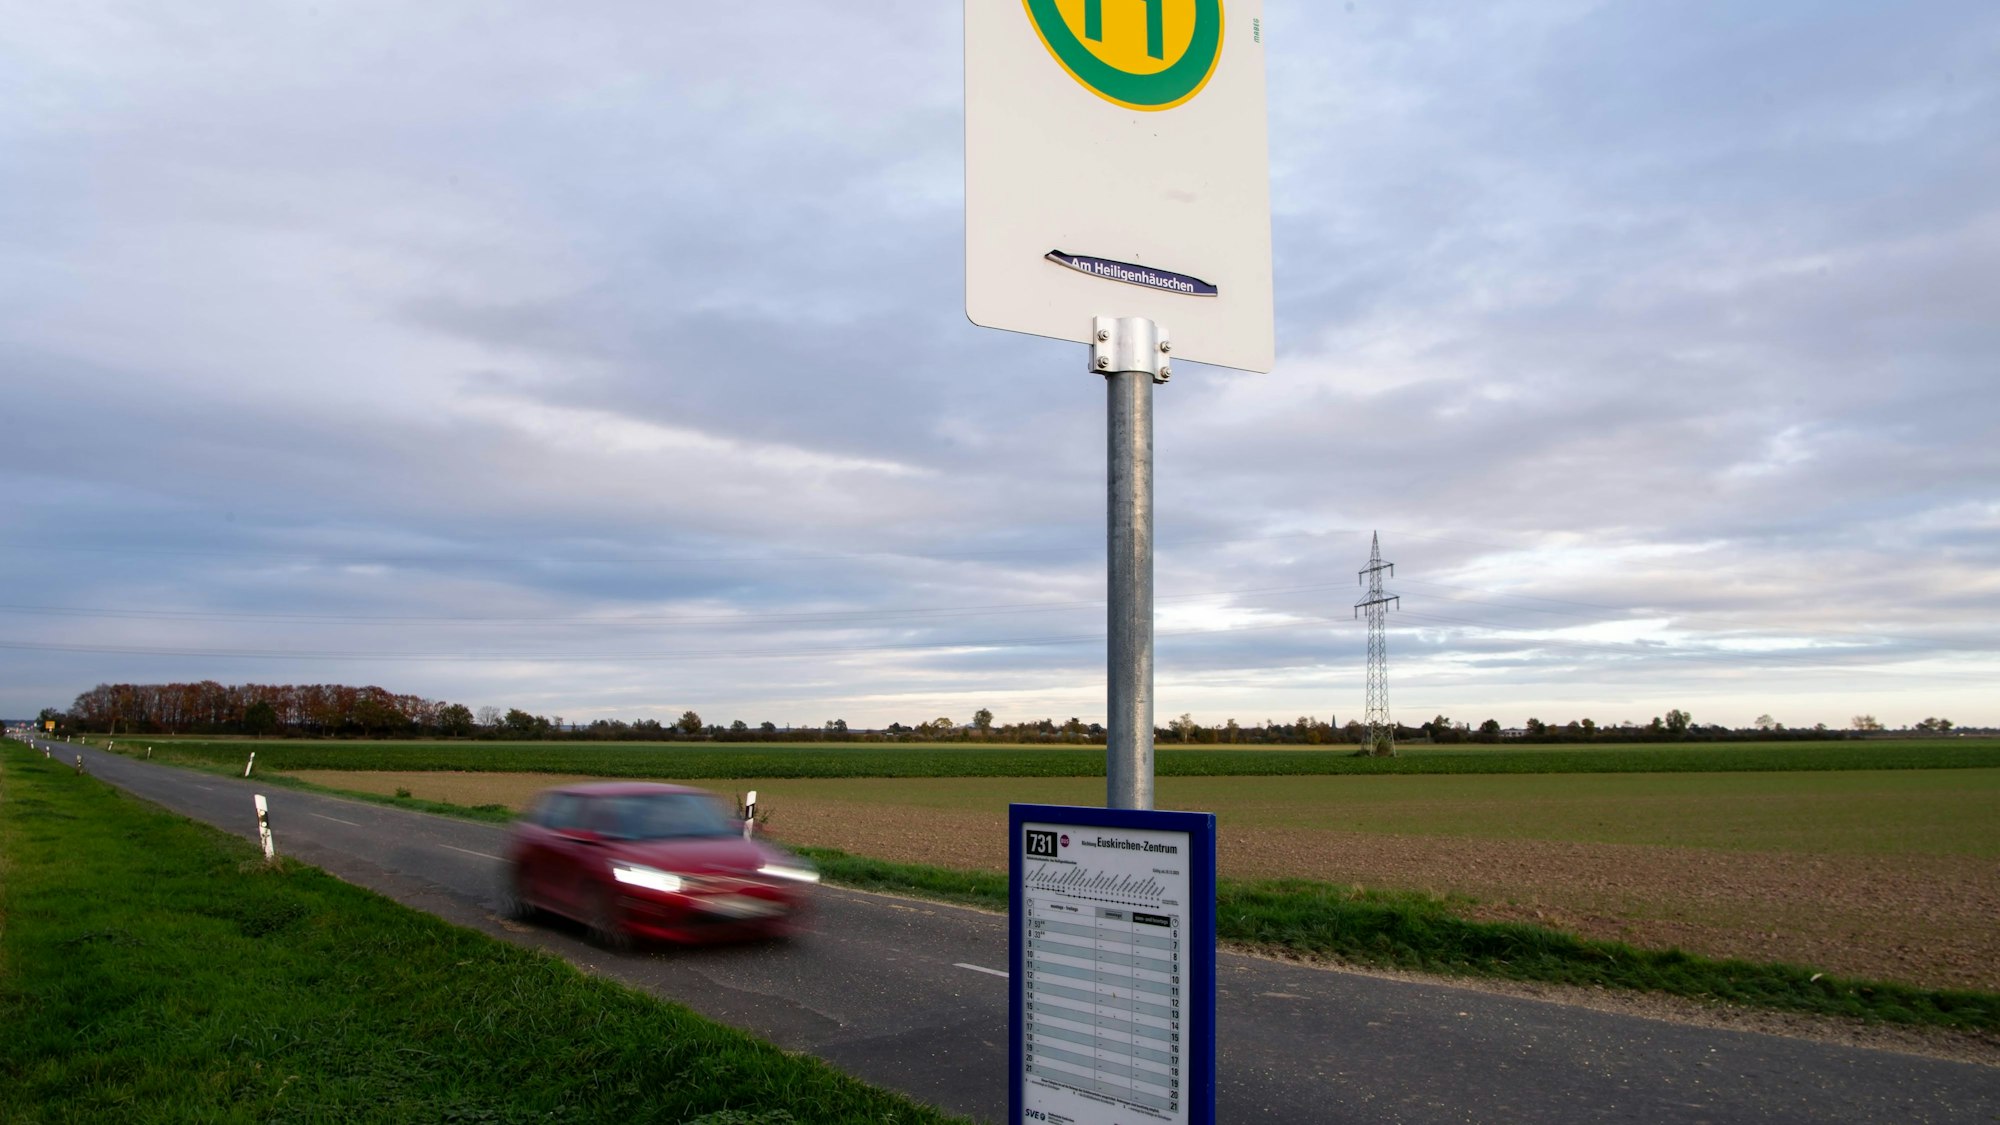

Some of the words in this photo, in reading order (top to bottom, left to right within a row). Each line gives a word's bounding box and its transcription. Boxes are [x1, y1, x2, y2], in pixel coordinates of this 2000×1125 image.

[1072, 258, 1092, 272] Am
[1094, 262, 1194, 293] Heiligenhäuschen
[1030, 833, 1052, 854] 731
[1097, 836, 1178, 854] Euskirchen-Zentrum
[1173, 930, 1178, 938] 6
[1173, 942, 1178, 950] 7
[1173, 953, 1178, 961] 8
[1173, 964, 1178, 972] 9
[1172, 976, 1178, 984] 10
[1172, 988, 1178, 996] 11
[1172, 999, 1178, 1007] 12
[1172, 1010, 1178, 1018] 13
[1172, 1022, 1178, 1030] 14
[1172, 1034, 1178, 1042] 15
[1171, 1045, 1178, 1053] 16
[1171, 1056, 1178, 1064] 17
[1171, 1068, 1178, 1076] 18
[1171, 1080, 1178, 1088] 19
[1171, 1091, 1178, 1099] 20
[1171, 1102, 1178, 1110] 21
[1025, 1108, 1039, 1119] SVE
